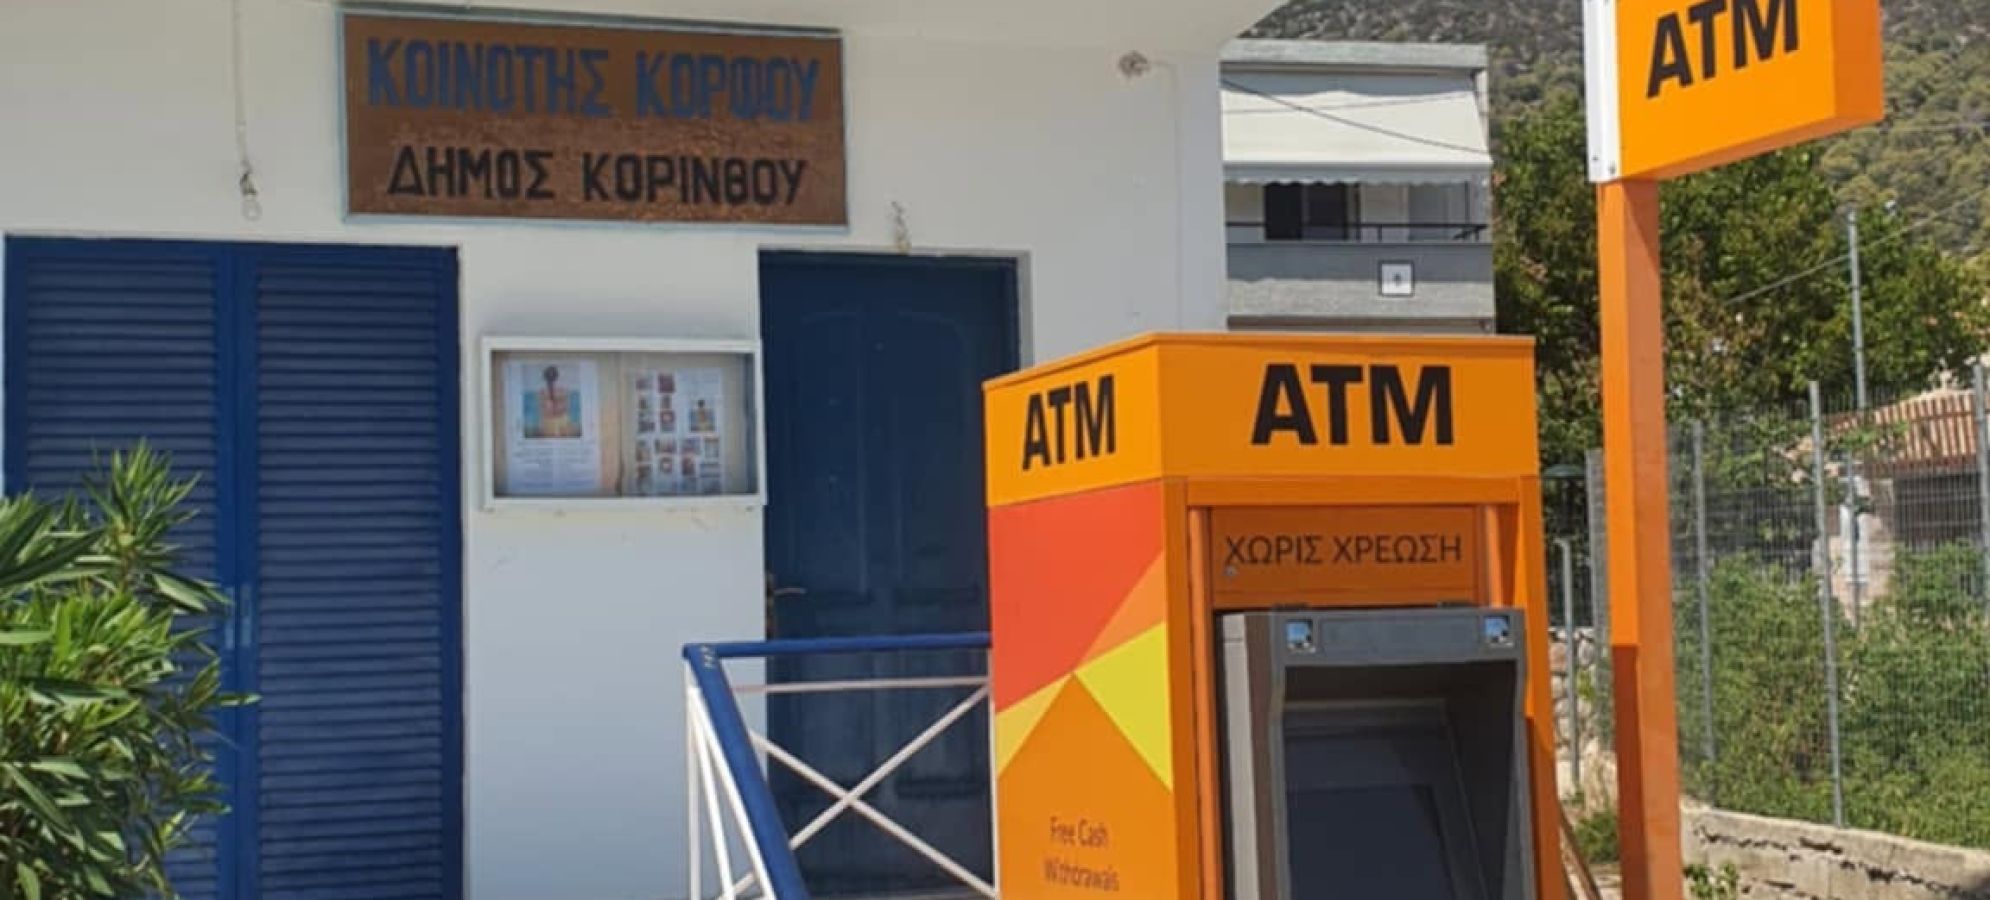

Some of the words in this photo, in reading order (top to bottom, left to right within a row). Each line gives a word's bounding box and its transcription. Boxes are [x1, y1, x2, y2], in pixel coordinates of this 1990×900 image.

[367, 38, 610, 118] ΚΟΙΝΟΤΗΣ
[635, 50, 820, 121] ΚΟΡΦΟΥ
[1647, 0, 1799, 99] ATM
[387, 145, 555, 199] ΔΗΜΟΣ
[582, 153, 807, 207] ΚΟΡΙΝΘΟΥ
[1022, 374, 1116, 470] ATM
[1250, 363, 1455, 446] ATM
[1225, 535, 1323, 566] ΧΩΡΙΣ
[1333, 533, 1463, 564] ΧΡΕΩΣΗ
